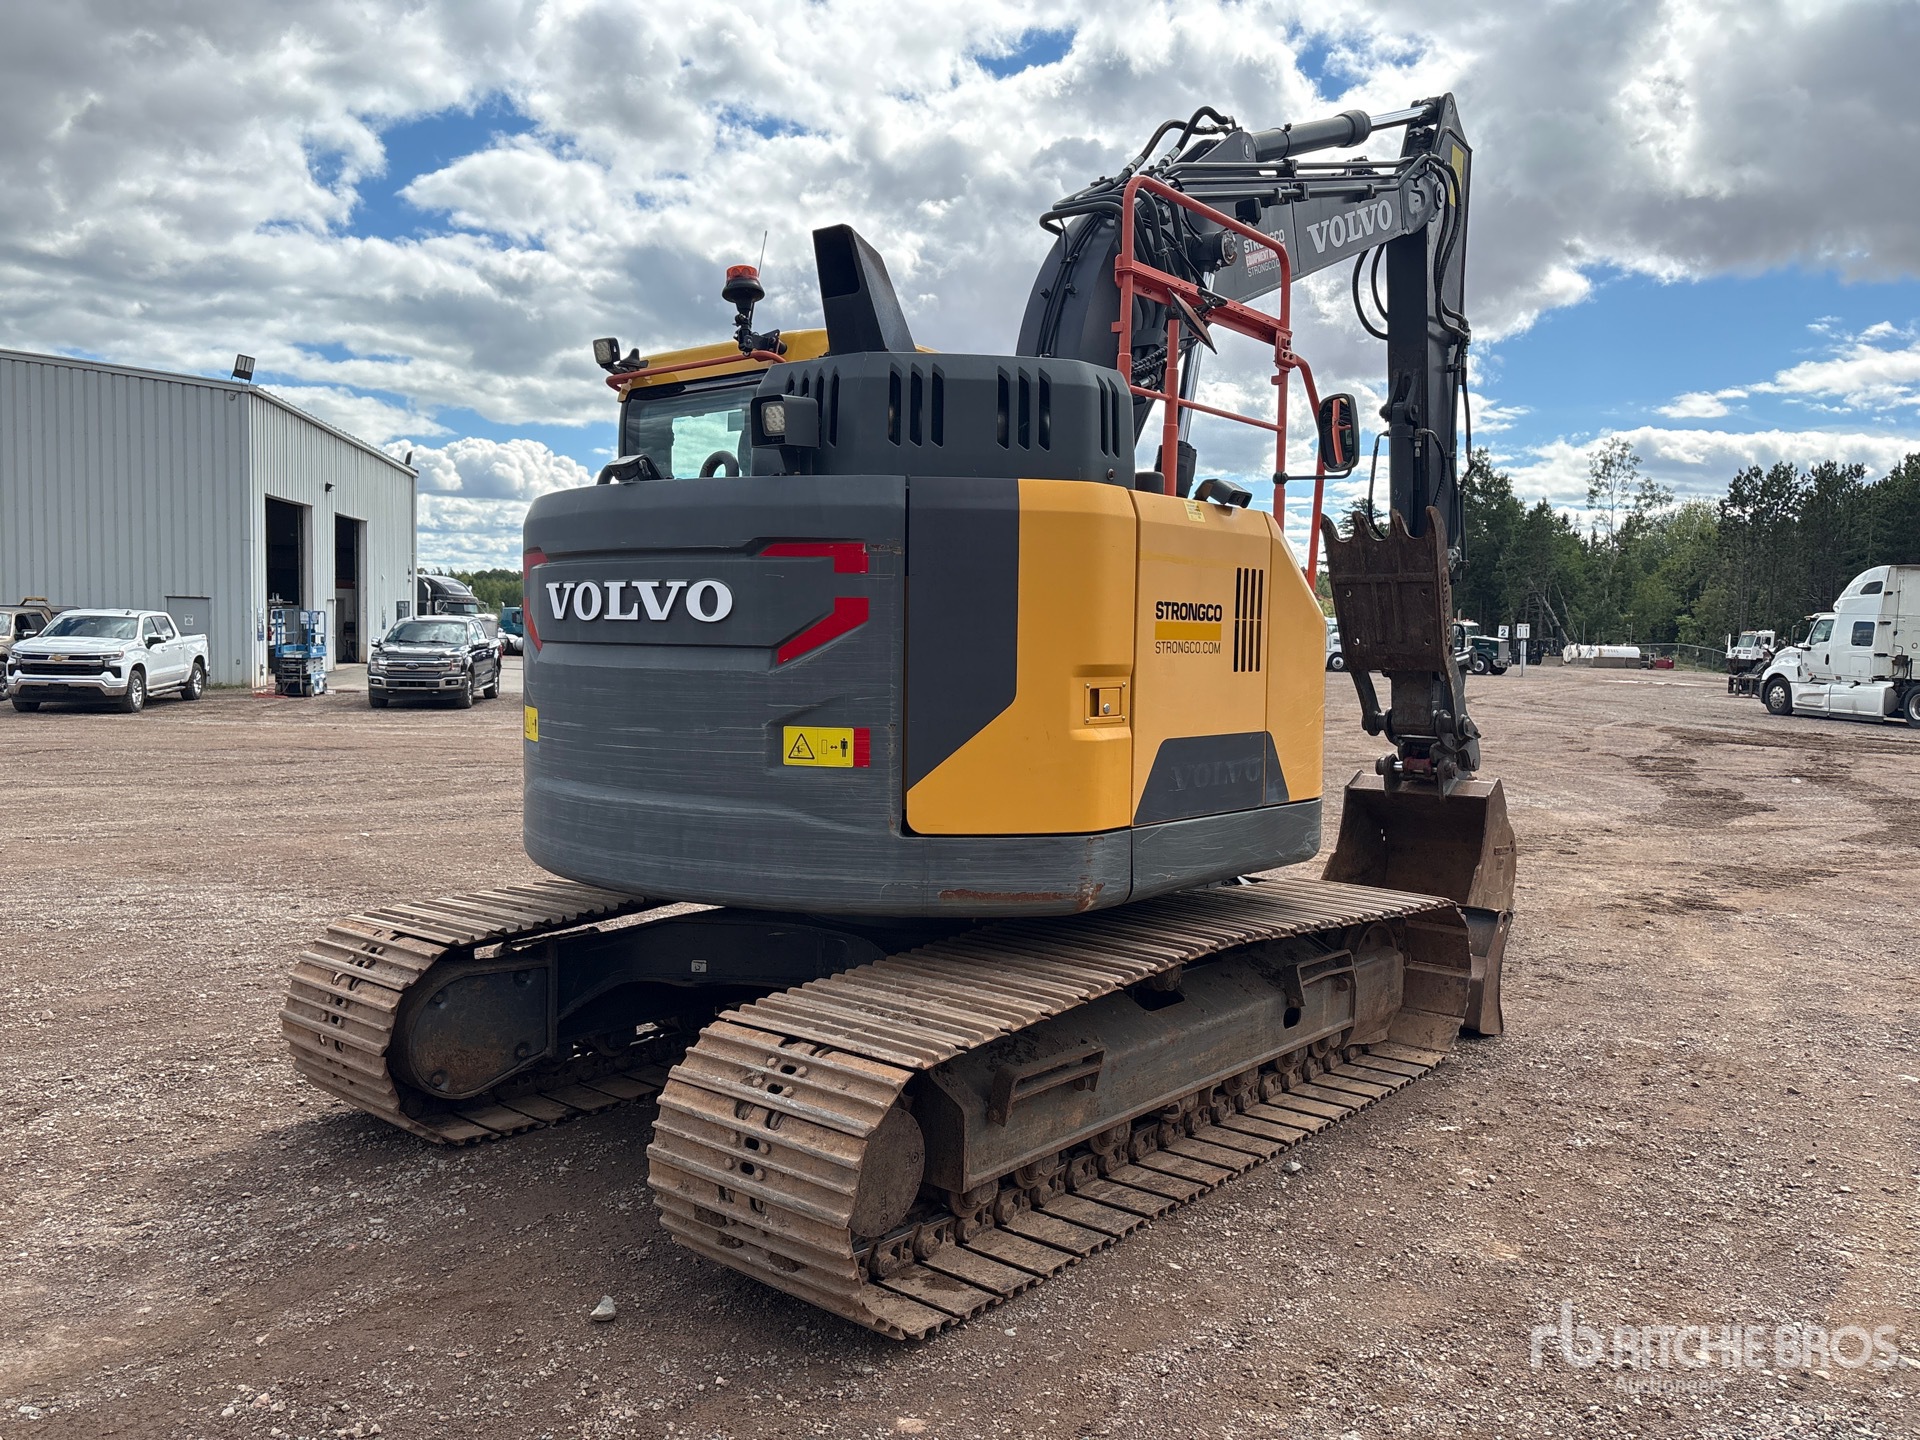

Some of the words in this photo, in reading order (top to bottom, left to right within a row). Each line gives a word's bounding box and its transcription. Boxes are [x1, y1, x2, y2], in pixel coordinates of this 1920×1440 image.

[1307, 200, 1393, 253] VOLVO
[546, 580, 733, 622] VOLVO
[1155, 601, 1223, 622] STRONGCO
[1155, 641, 1221, 654] STRONGCO.COM
[1171, 758, 1260, 789] VOLVO
